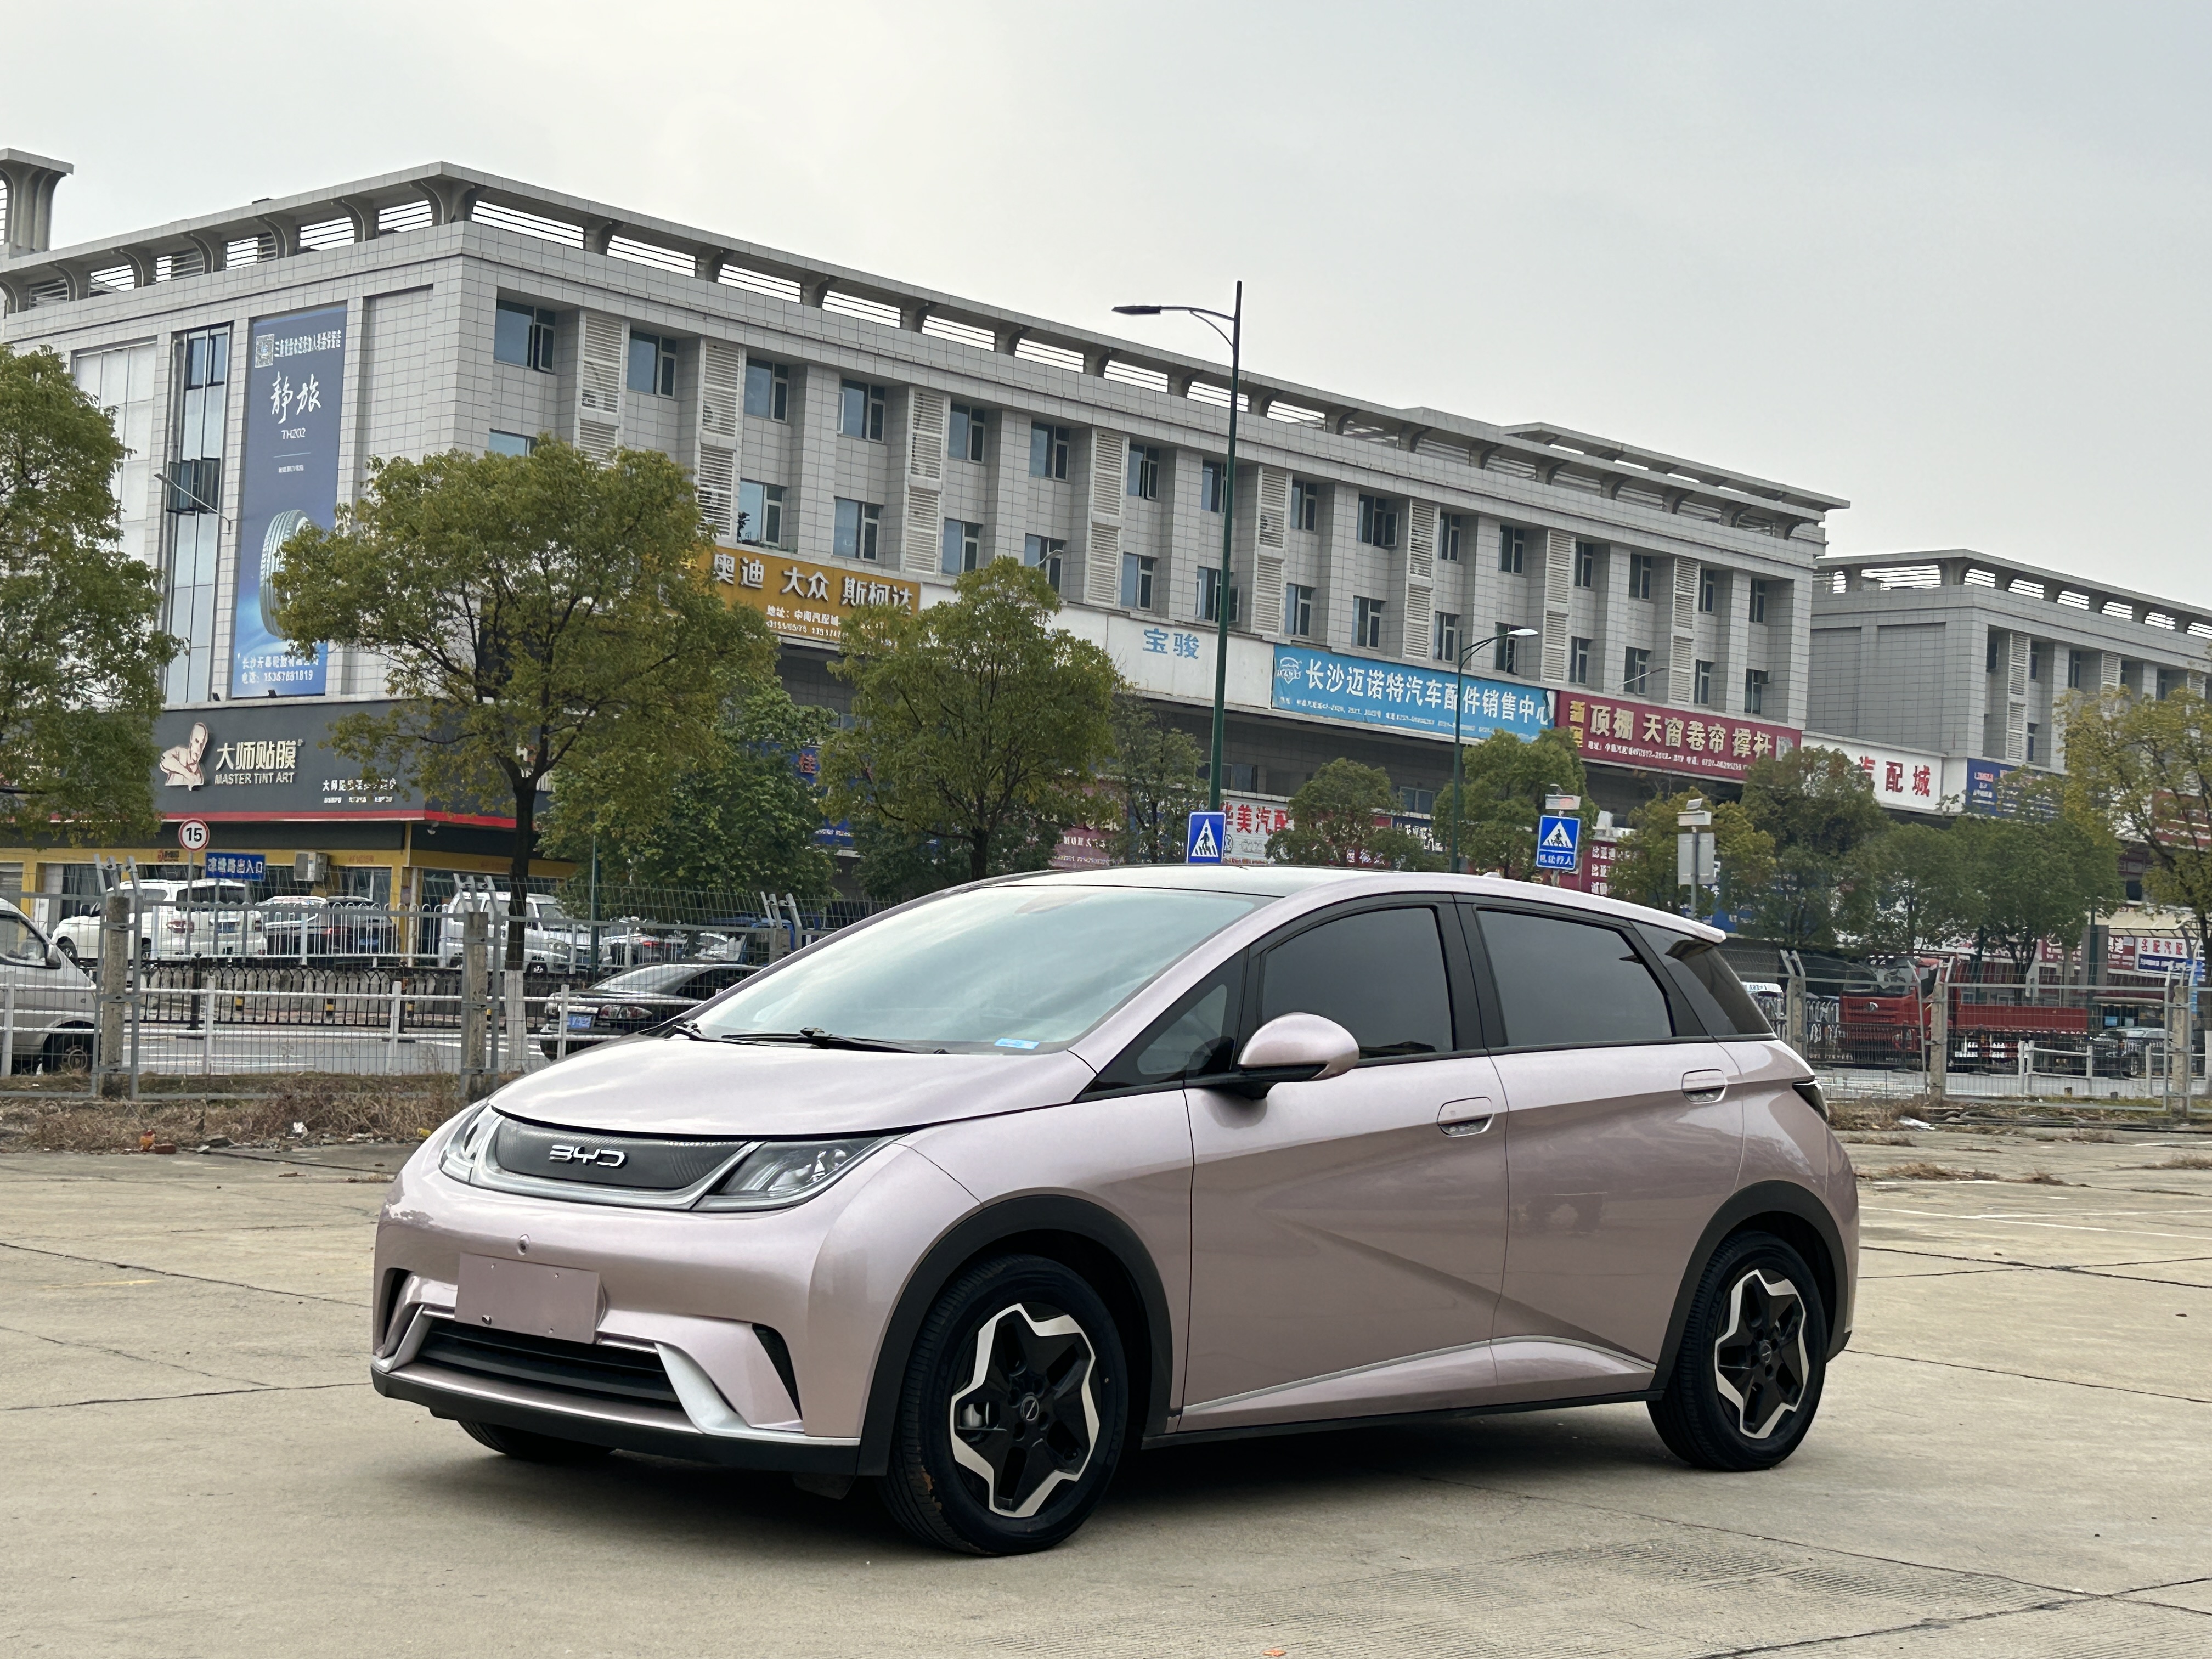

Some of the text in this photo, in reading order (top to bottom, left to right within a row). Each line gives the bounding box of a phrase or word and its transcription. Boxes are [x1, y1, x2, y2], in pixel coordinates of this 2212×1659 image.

[713, 554, 913, 616] 奥迪 大众 斯柯达
[1143, 628, 1199, 659] 宝骏
[1306, 658, 1549, 725] 长沙迈诺特汽车配件销售中心
[216, 740, 296, 771] 大师贴膜
[215, 772, 295, 785] MASTER TINT ART
[186, 827, 202, 842] 15
[549, 1145, 625, 1166] BYD
